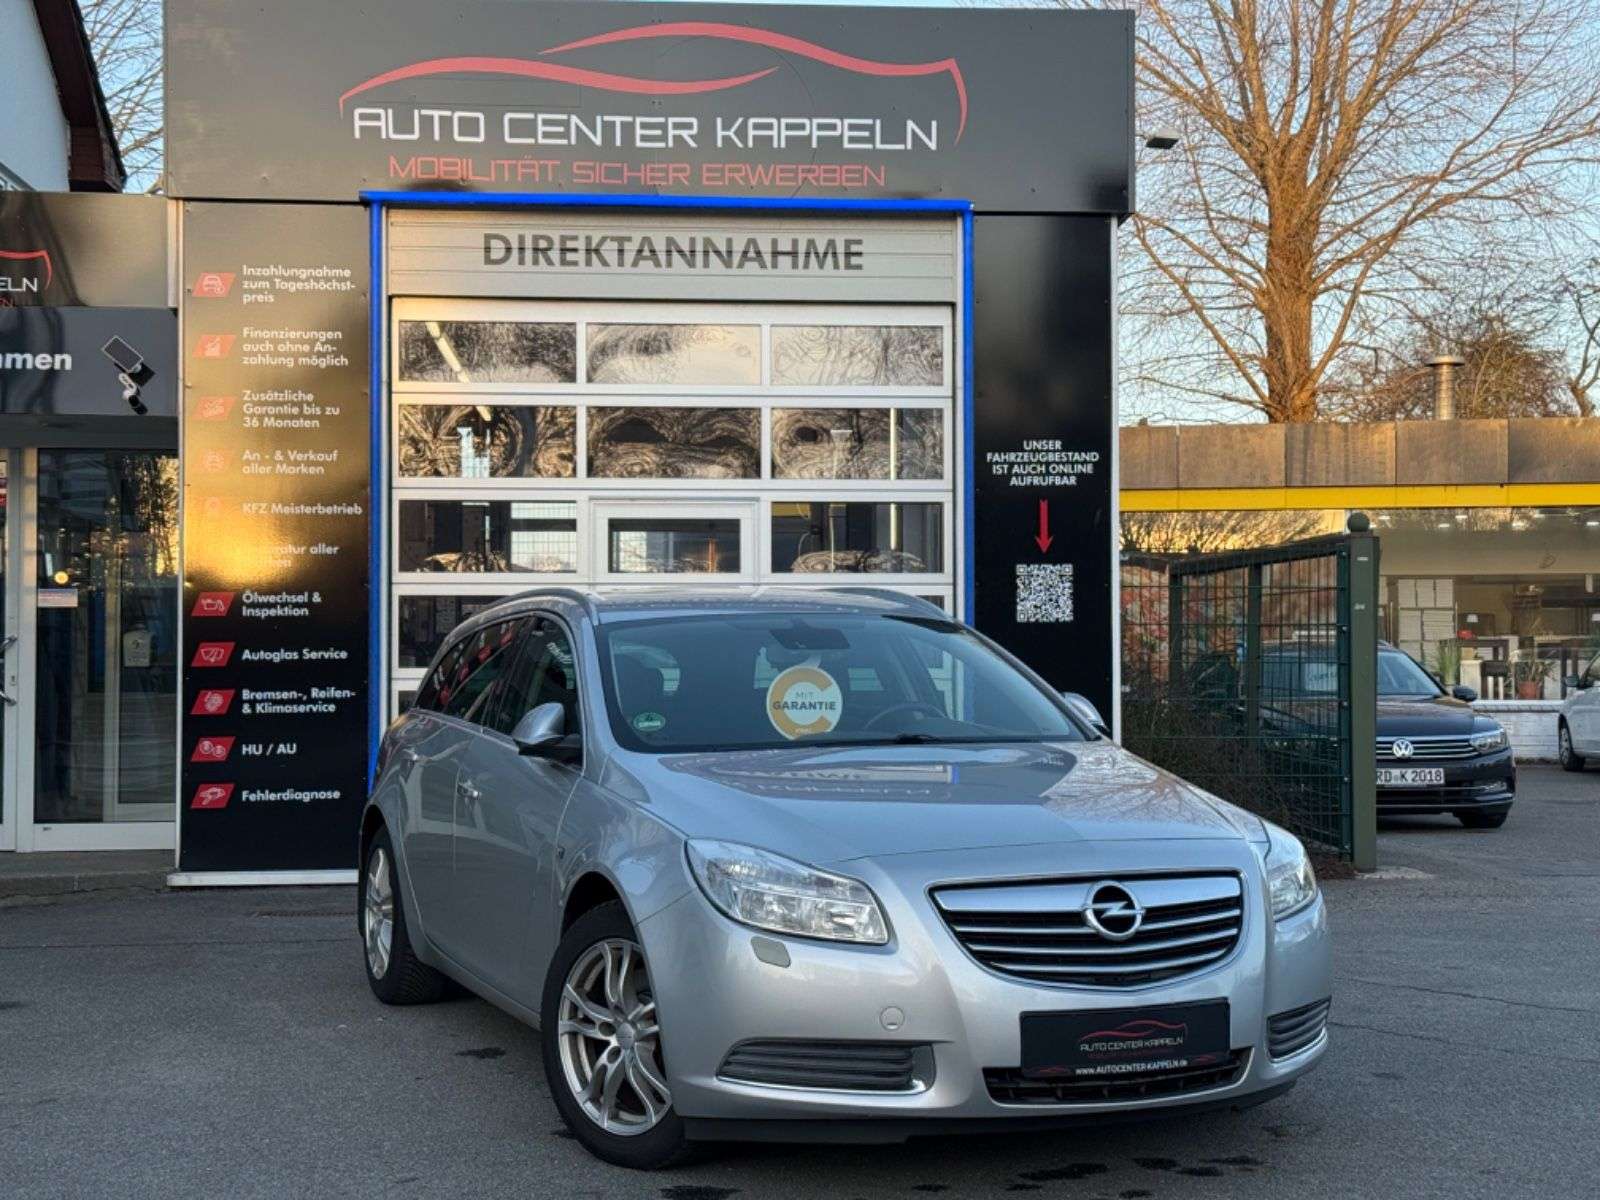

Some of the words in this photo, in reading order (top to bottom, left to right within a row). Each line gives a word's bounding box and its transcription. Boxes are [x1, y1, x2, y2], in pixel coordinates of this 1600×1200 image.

[353, 107, 485, 142] AUTO
[503, 112, 698, 148] CENTER
[716, 117, 938, 150] KAPPELN
[389, 154, 561, 182] MOBILITÄT
[572, 161, 691, 185] SICHER
[701, 163, 886, 187] ERWERBEN
[483, 232, 864, 272] DIREKTANNAHME
[242, 265, 352, 279] Inzahlungnahme
[242, 280, 270, 290] zum
[274, 277, 356, 293] Tageshöchst-
[242, 293, 275, 305] preis
[242, 327, 342, 342] Finanzierungen
[242, 341, 274, 352] auch
[277, 341, 310, 352] ohne
[314, 341, 337, 352] An-
[0, 353, 72, 371] men
[242, 355, 294, 368] zahlung
[299, 355, 348, 369] möglich
[242, 389, 314, 402] Zusätzliche
[242, 403, 300, 416] Garantie
[303, 403, 321, 416] bis
[325, 406, 340, 416] zu
[242, 417, 259, 428] 36
[263, 417, 320, 428] Monaten
[1023, 439, 1062, 450] UNSER
[274, 450, 284, 461] &
[288, 449, 339, 461] Verkauf
[986, 451, 1100, 463] FAHRZEUGBESTAND
[242, 463, 272, 474] aller
[275, 463, 325, 474] Marken
[992, 464, 1009, 475] IST
[1012, 463, 1045, 475] AUCH
[1049, 463, 1094, 474] ONLINE
[1009, 475, 1077, 487] AUFRUFBAR
[242, 503, 269, 514] KFZ
[271, 502, 363, 515] Meisterbetrieb
[309, 543, 339, 555] aller
[242, 589, 309, 603] Ölwechsel
[312, 591, 322, 603] &
[242, 605, 309, 619] Inspektion
[242, 648, 299, 663] Autoglas
[302, 647, 348, 660] Service
[310, 686, 356, 699] Reifen-
[242, 702, 252, 714] &
[255, 701, 336, 714] Klimaservice
[772, 701, 837, 711] GARANTIE
[242, 743, 263, 755] HU
[277, 743, 297, 755] AU
[1411, 769, 1442, 782] 2018
[242, 788, 341, 802] Fehlerdiagnose
